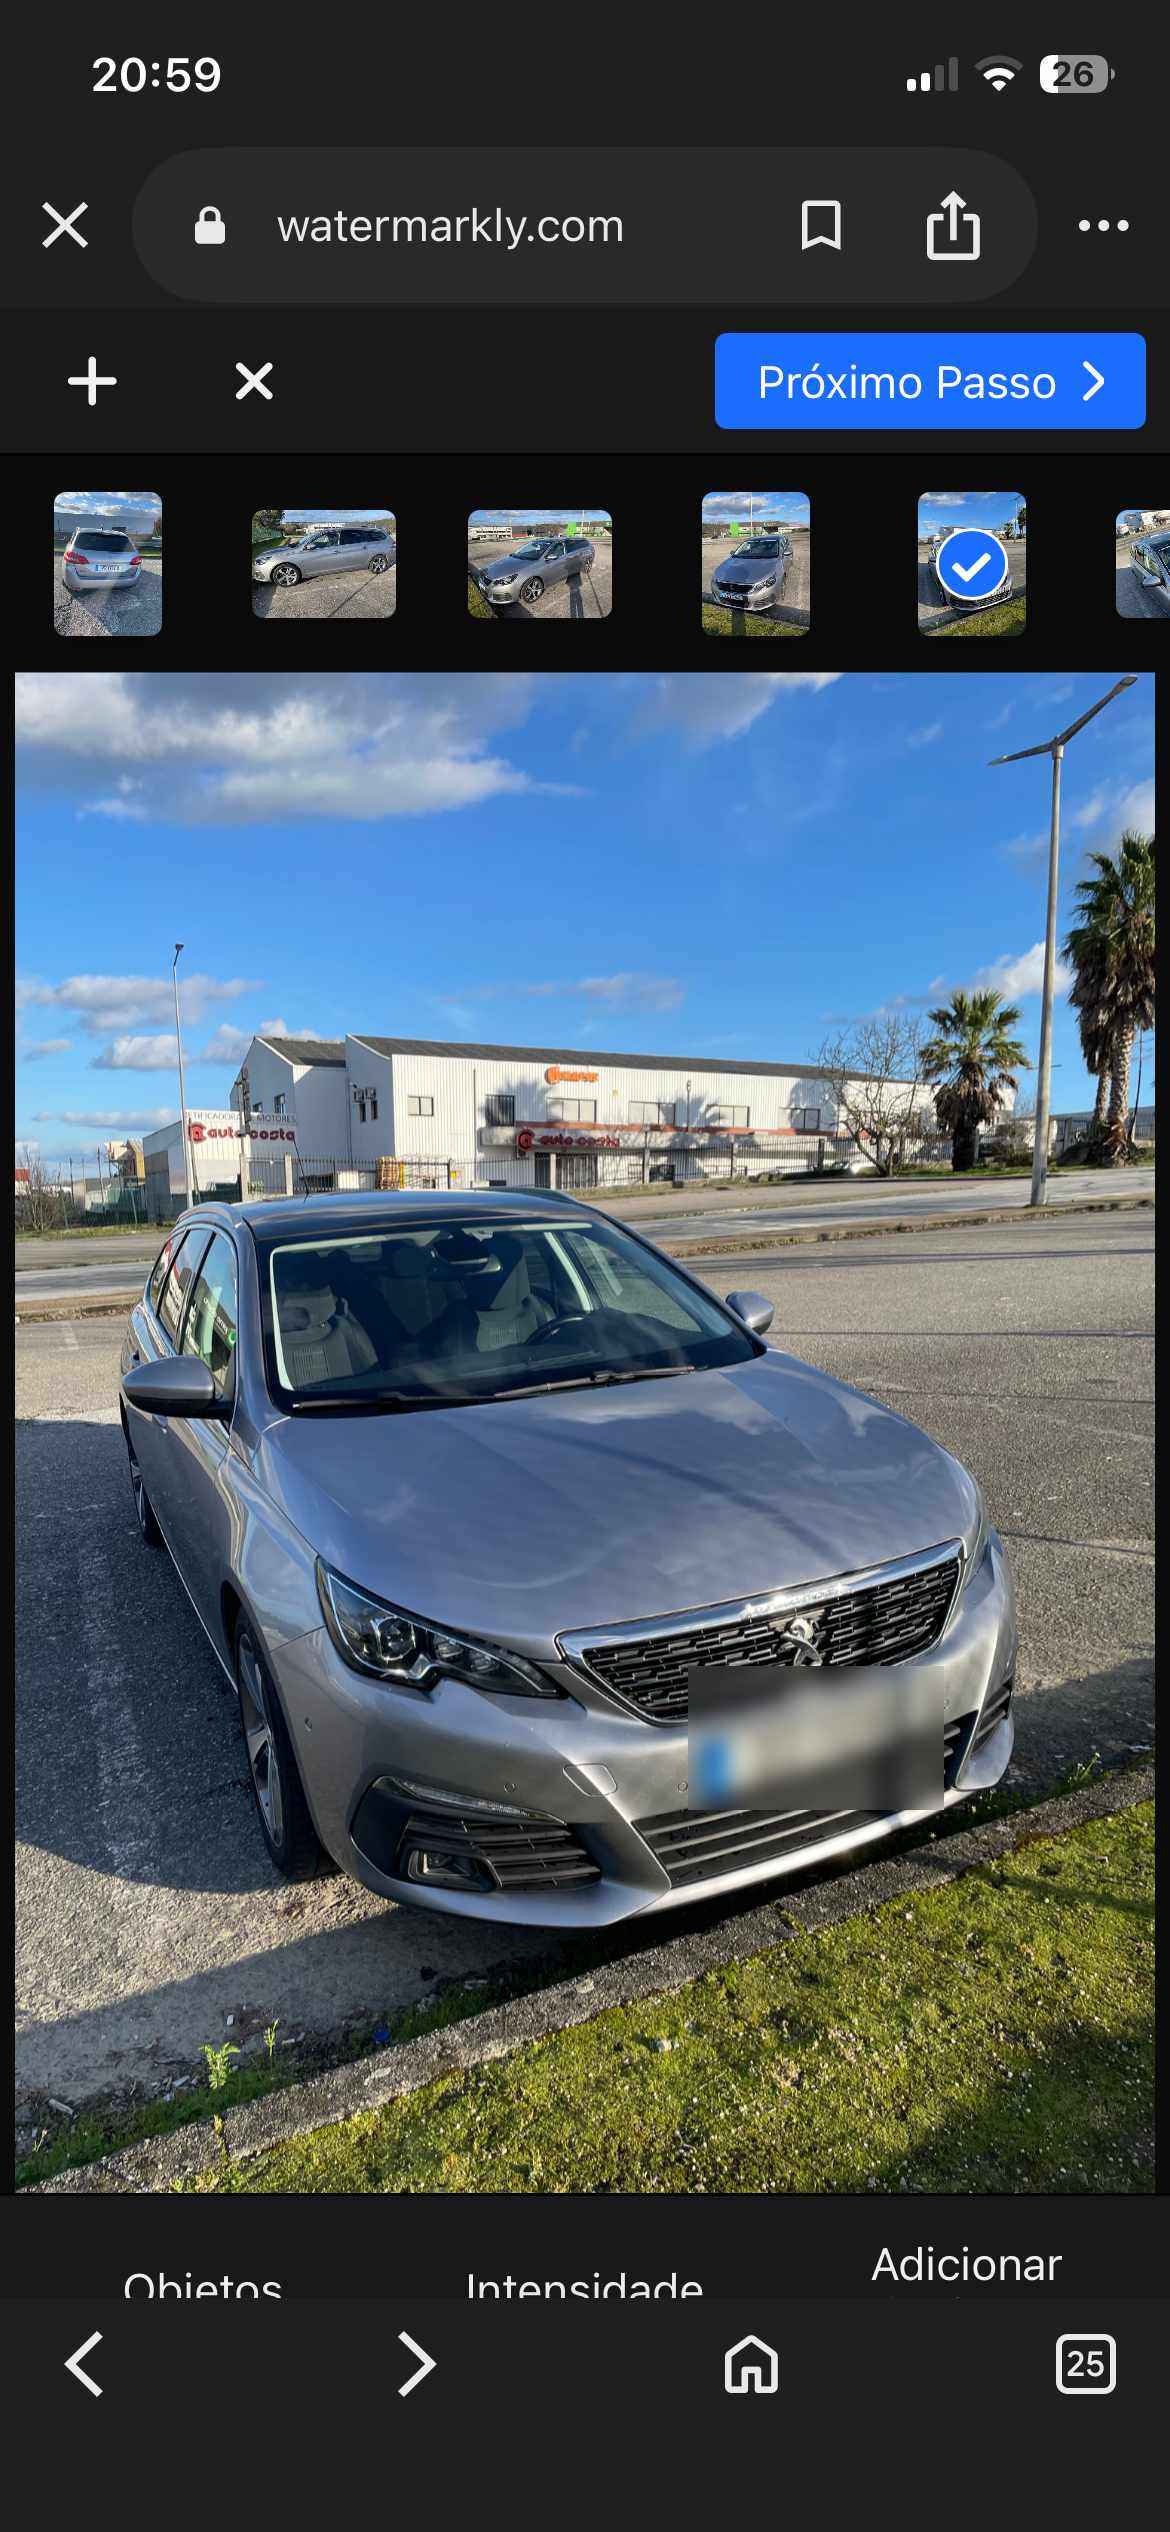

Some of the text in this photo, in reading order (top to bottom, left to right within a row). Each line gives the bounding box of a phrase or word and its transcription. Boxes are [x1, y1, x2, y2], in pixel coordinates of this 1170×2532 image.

[92, 56, 221, 93] 20:59
[1053, 60, 1094, 87] 26
[277, 206, 624, 250] watermarkly.com
[760, 362, 1056, 400] Próximo Passo
[540, 1133, 573, 1146] auto
[871, 2246, 1063, 2281] Adicionar
[124, 2272, 282, 2299] Objetos
[468, 2271, 704, 2299] Intensidade
[1066, 2350, 1105, 2378] 25
